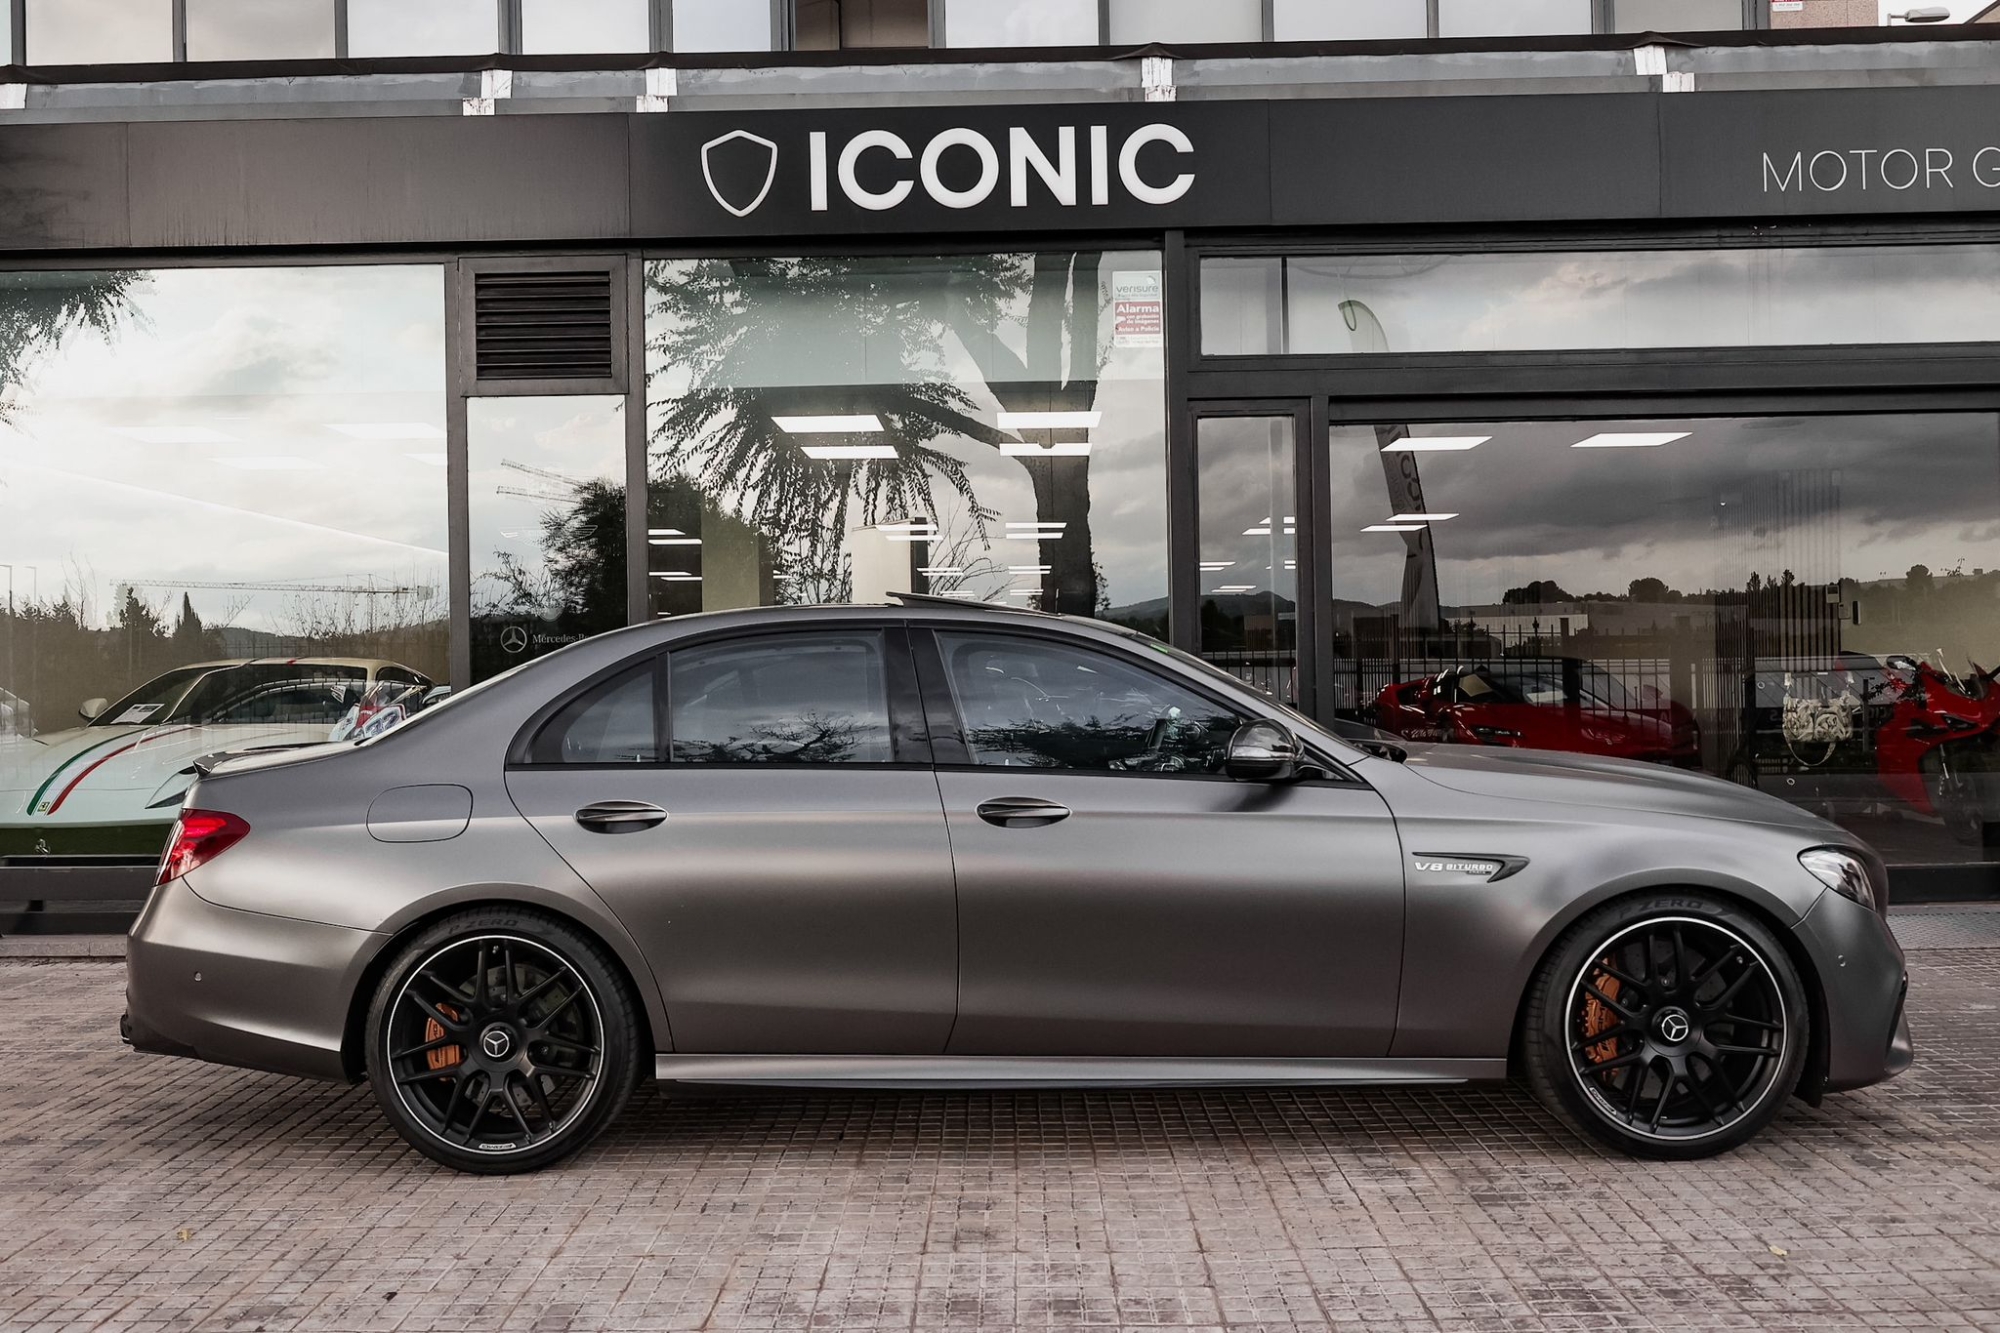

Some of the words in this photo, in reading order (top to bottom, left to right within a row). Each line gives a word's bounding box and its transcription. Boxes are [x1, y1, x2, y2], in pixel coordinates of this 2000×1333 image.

[809, 123, 1196, 211] ICONIC
[1763, 147, 1954, 192] MOTOR
[1116, 285, 1159, 293] verisure
[1117, 304, 1159, 313] Alarma
[1414, 861, 1443, 871] V8
[1446, 863, 1493, 871] BITURBO
[1639, 899, 1704, 911] ZERO
[465, 919, 519, 929] ZERO
